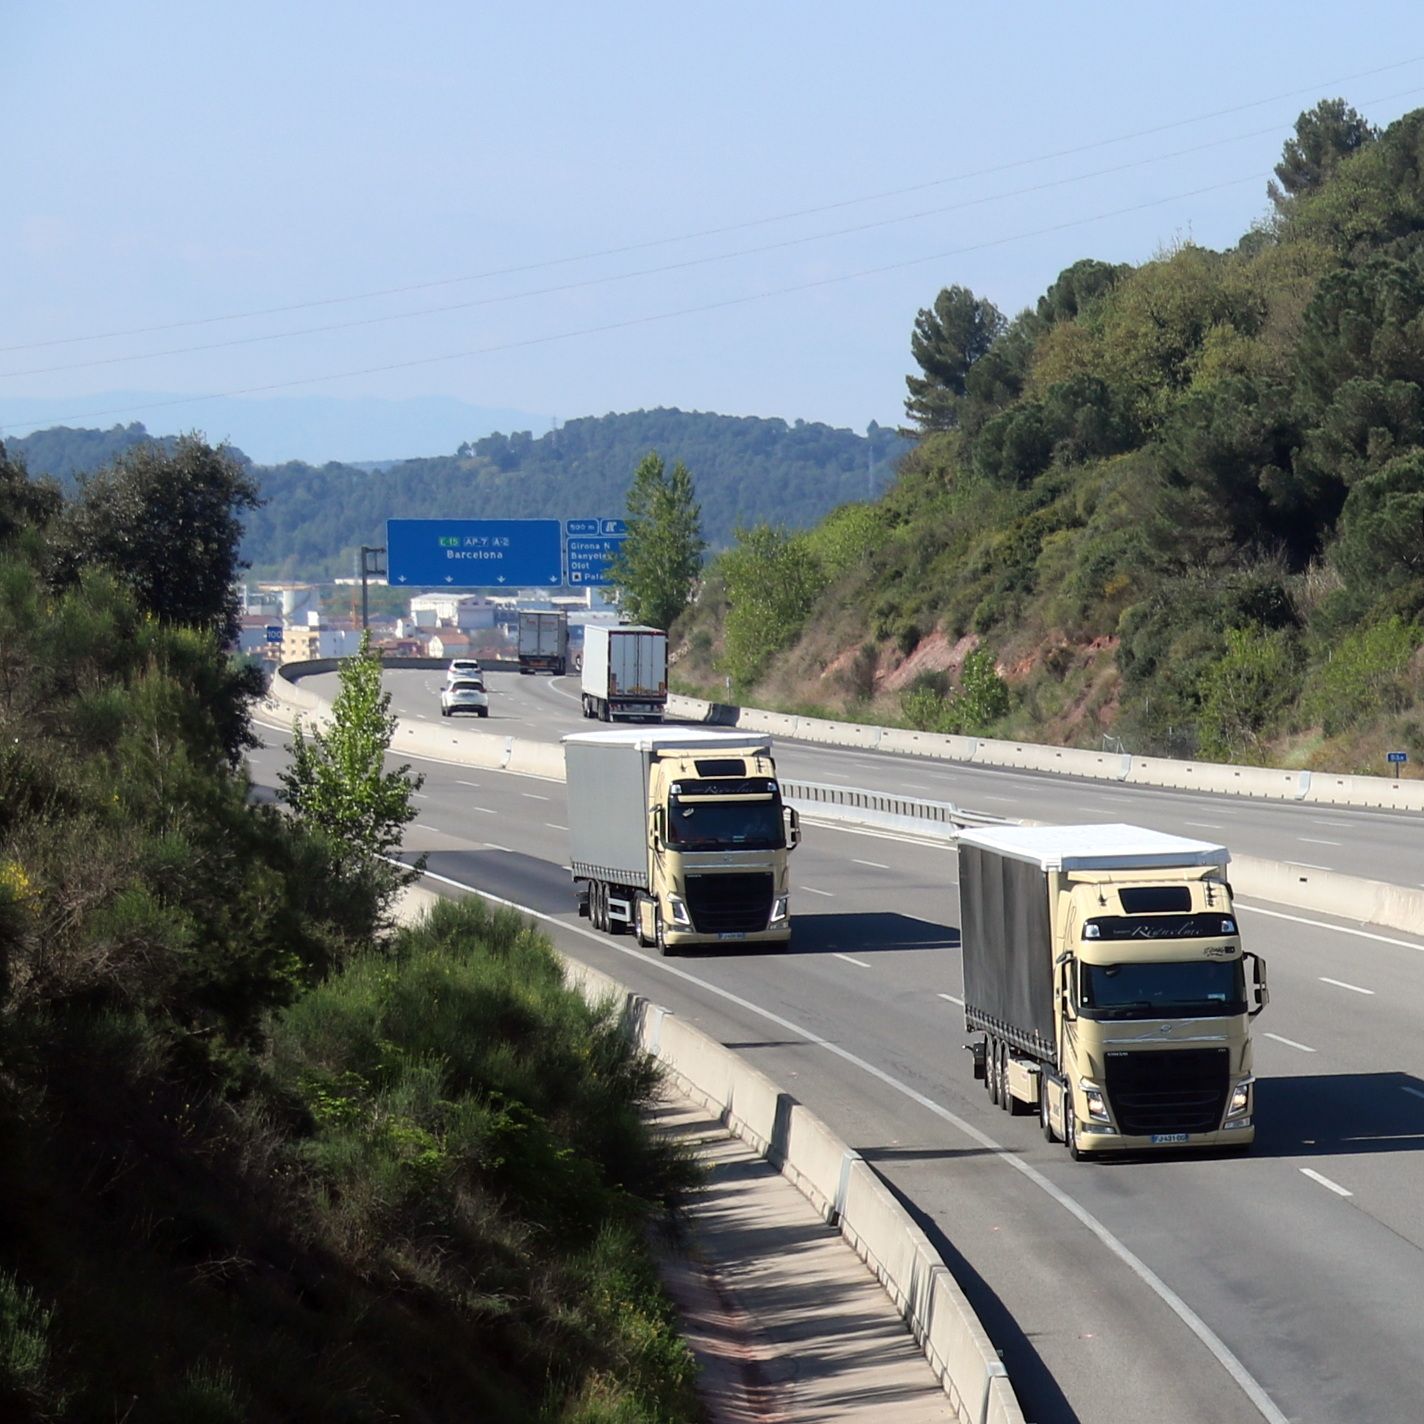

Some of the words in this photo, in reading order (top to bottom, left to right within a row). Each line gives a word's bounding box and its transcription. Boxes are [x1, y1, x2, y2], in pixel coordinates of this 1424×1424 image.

[571, 542, 600, 550] Girona
[604, 542, 610, 550] N
[447, 551, 503, 559] Barcelona
[571, 562, 590, 570] Olot
